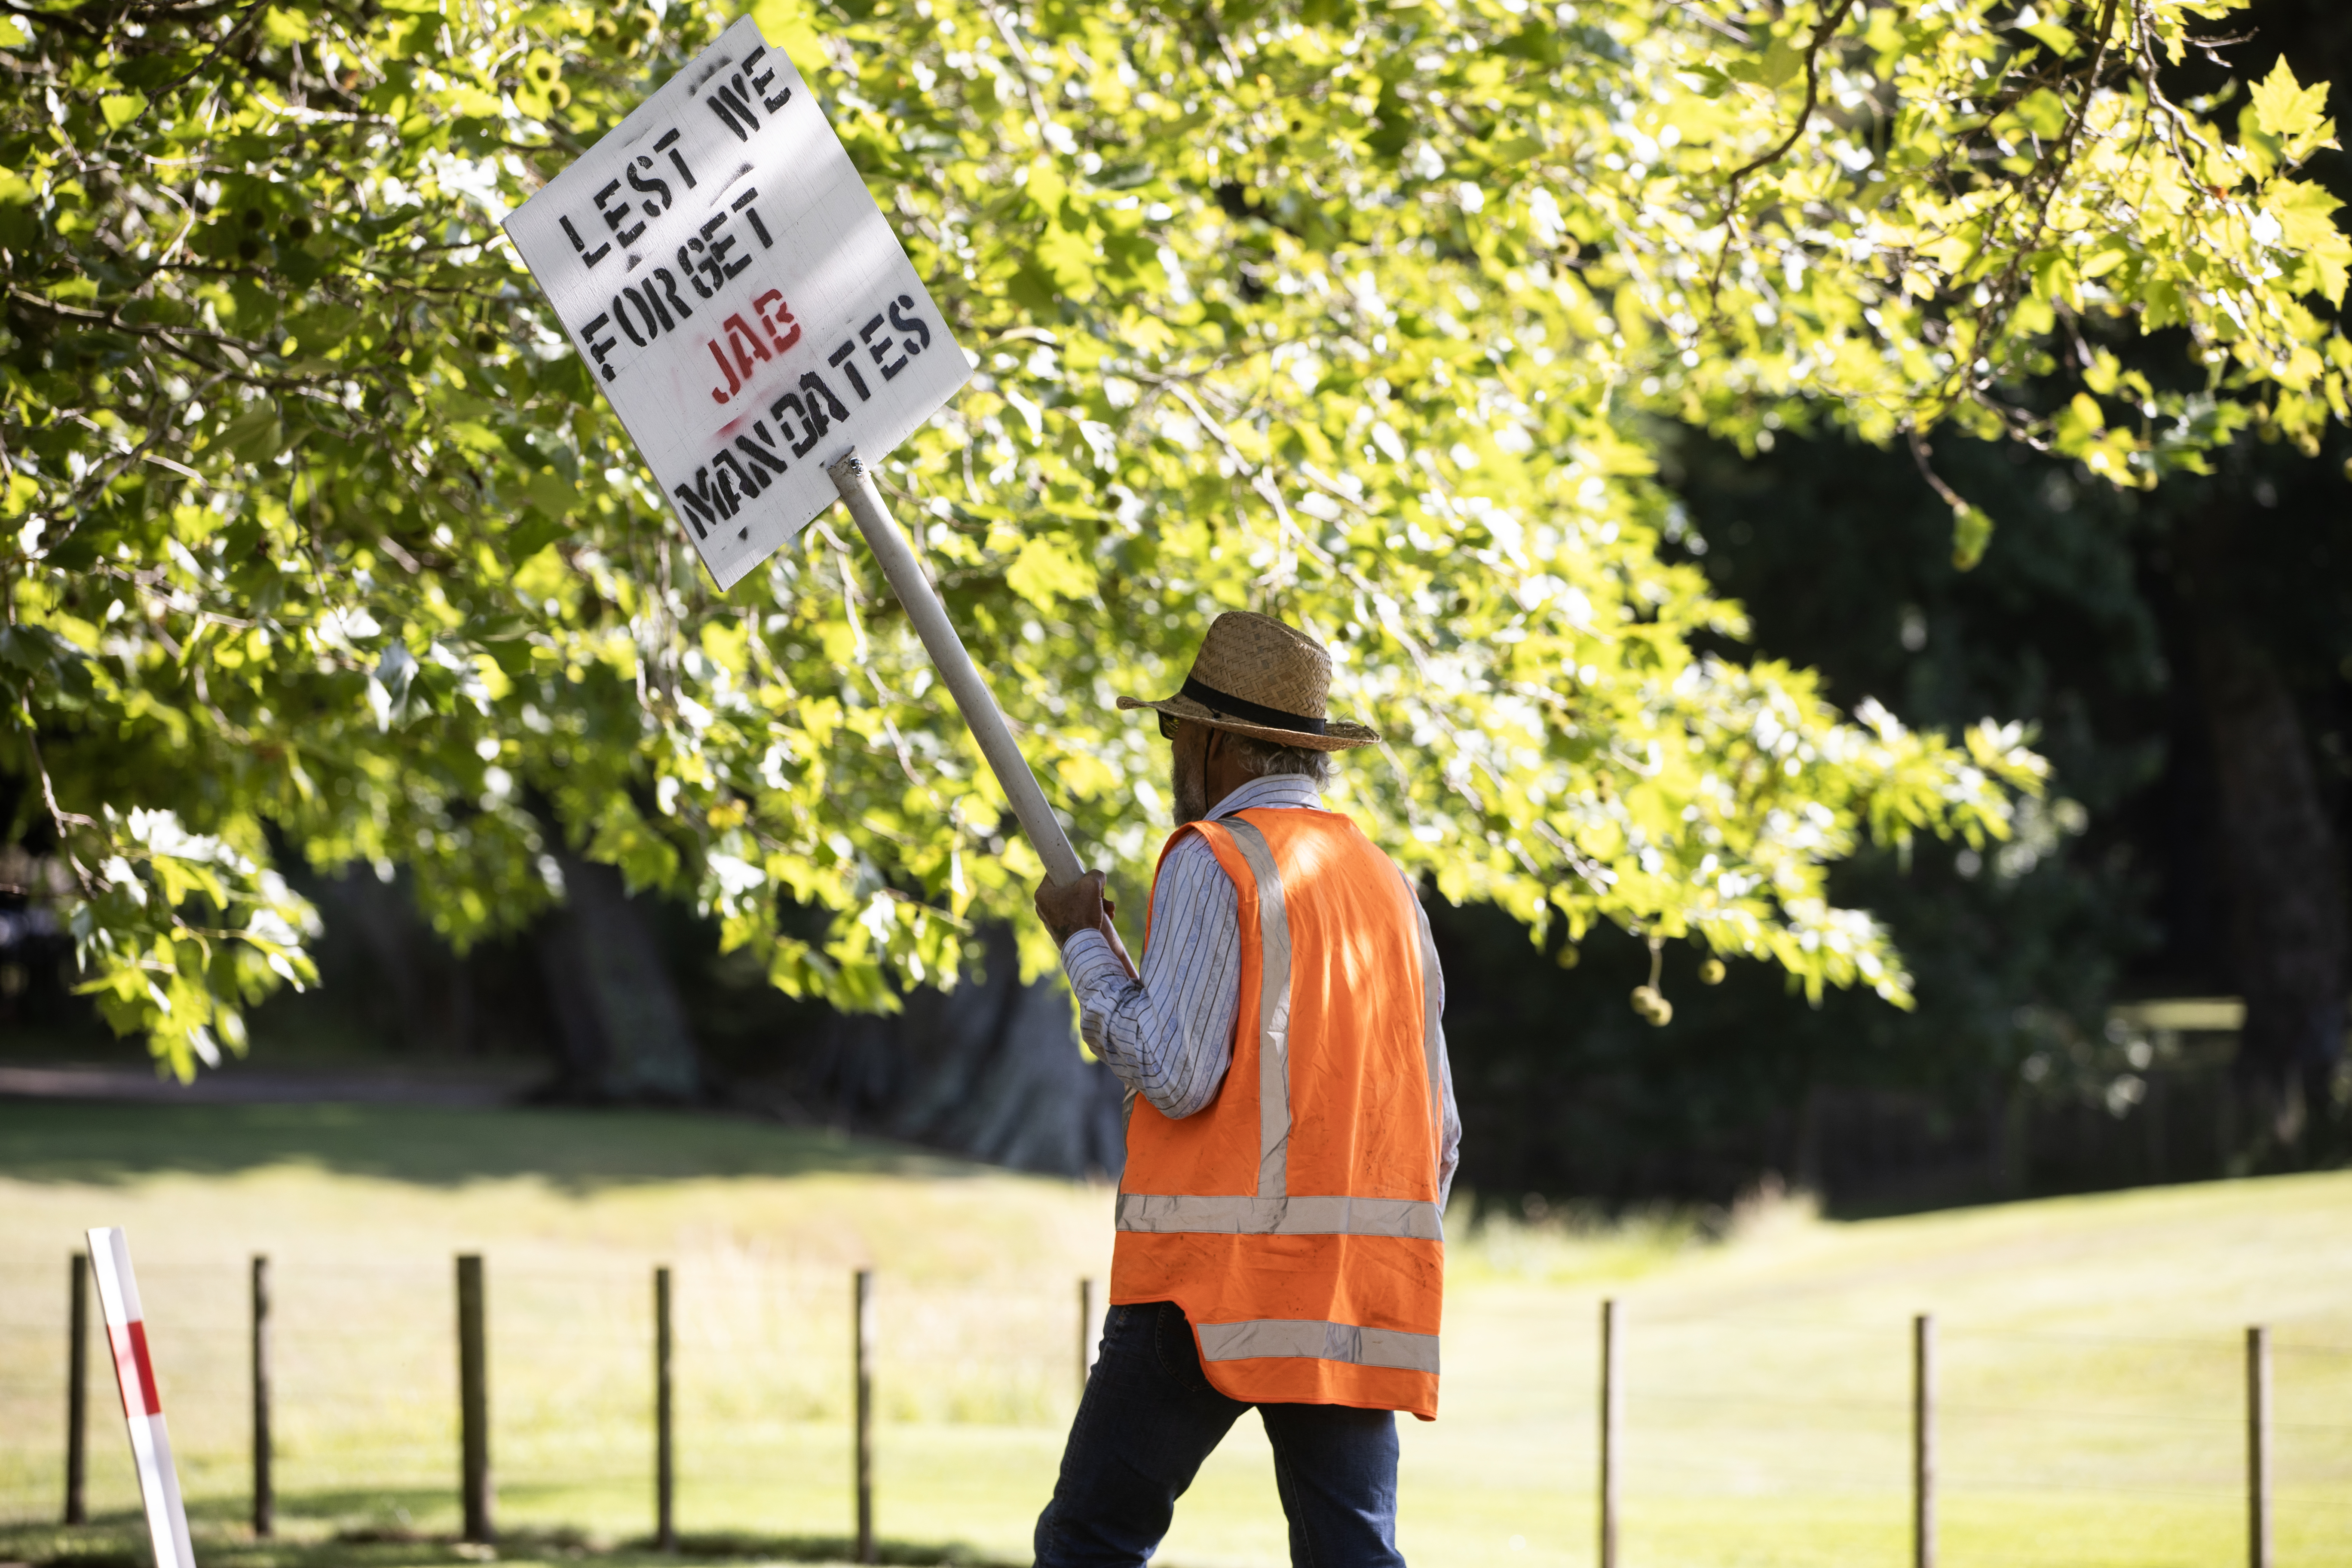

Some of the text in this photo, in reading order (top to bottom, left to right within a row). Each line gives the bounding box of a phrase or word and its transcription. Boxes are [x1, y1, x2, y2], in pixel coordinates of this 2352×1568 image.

[559, 46, 791, 269] LEST WE
[580, 187, 773, 382] FORGET
[707, 288, 801, 404] JAB
[674, 295, 931, 539] MANDATES
